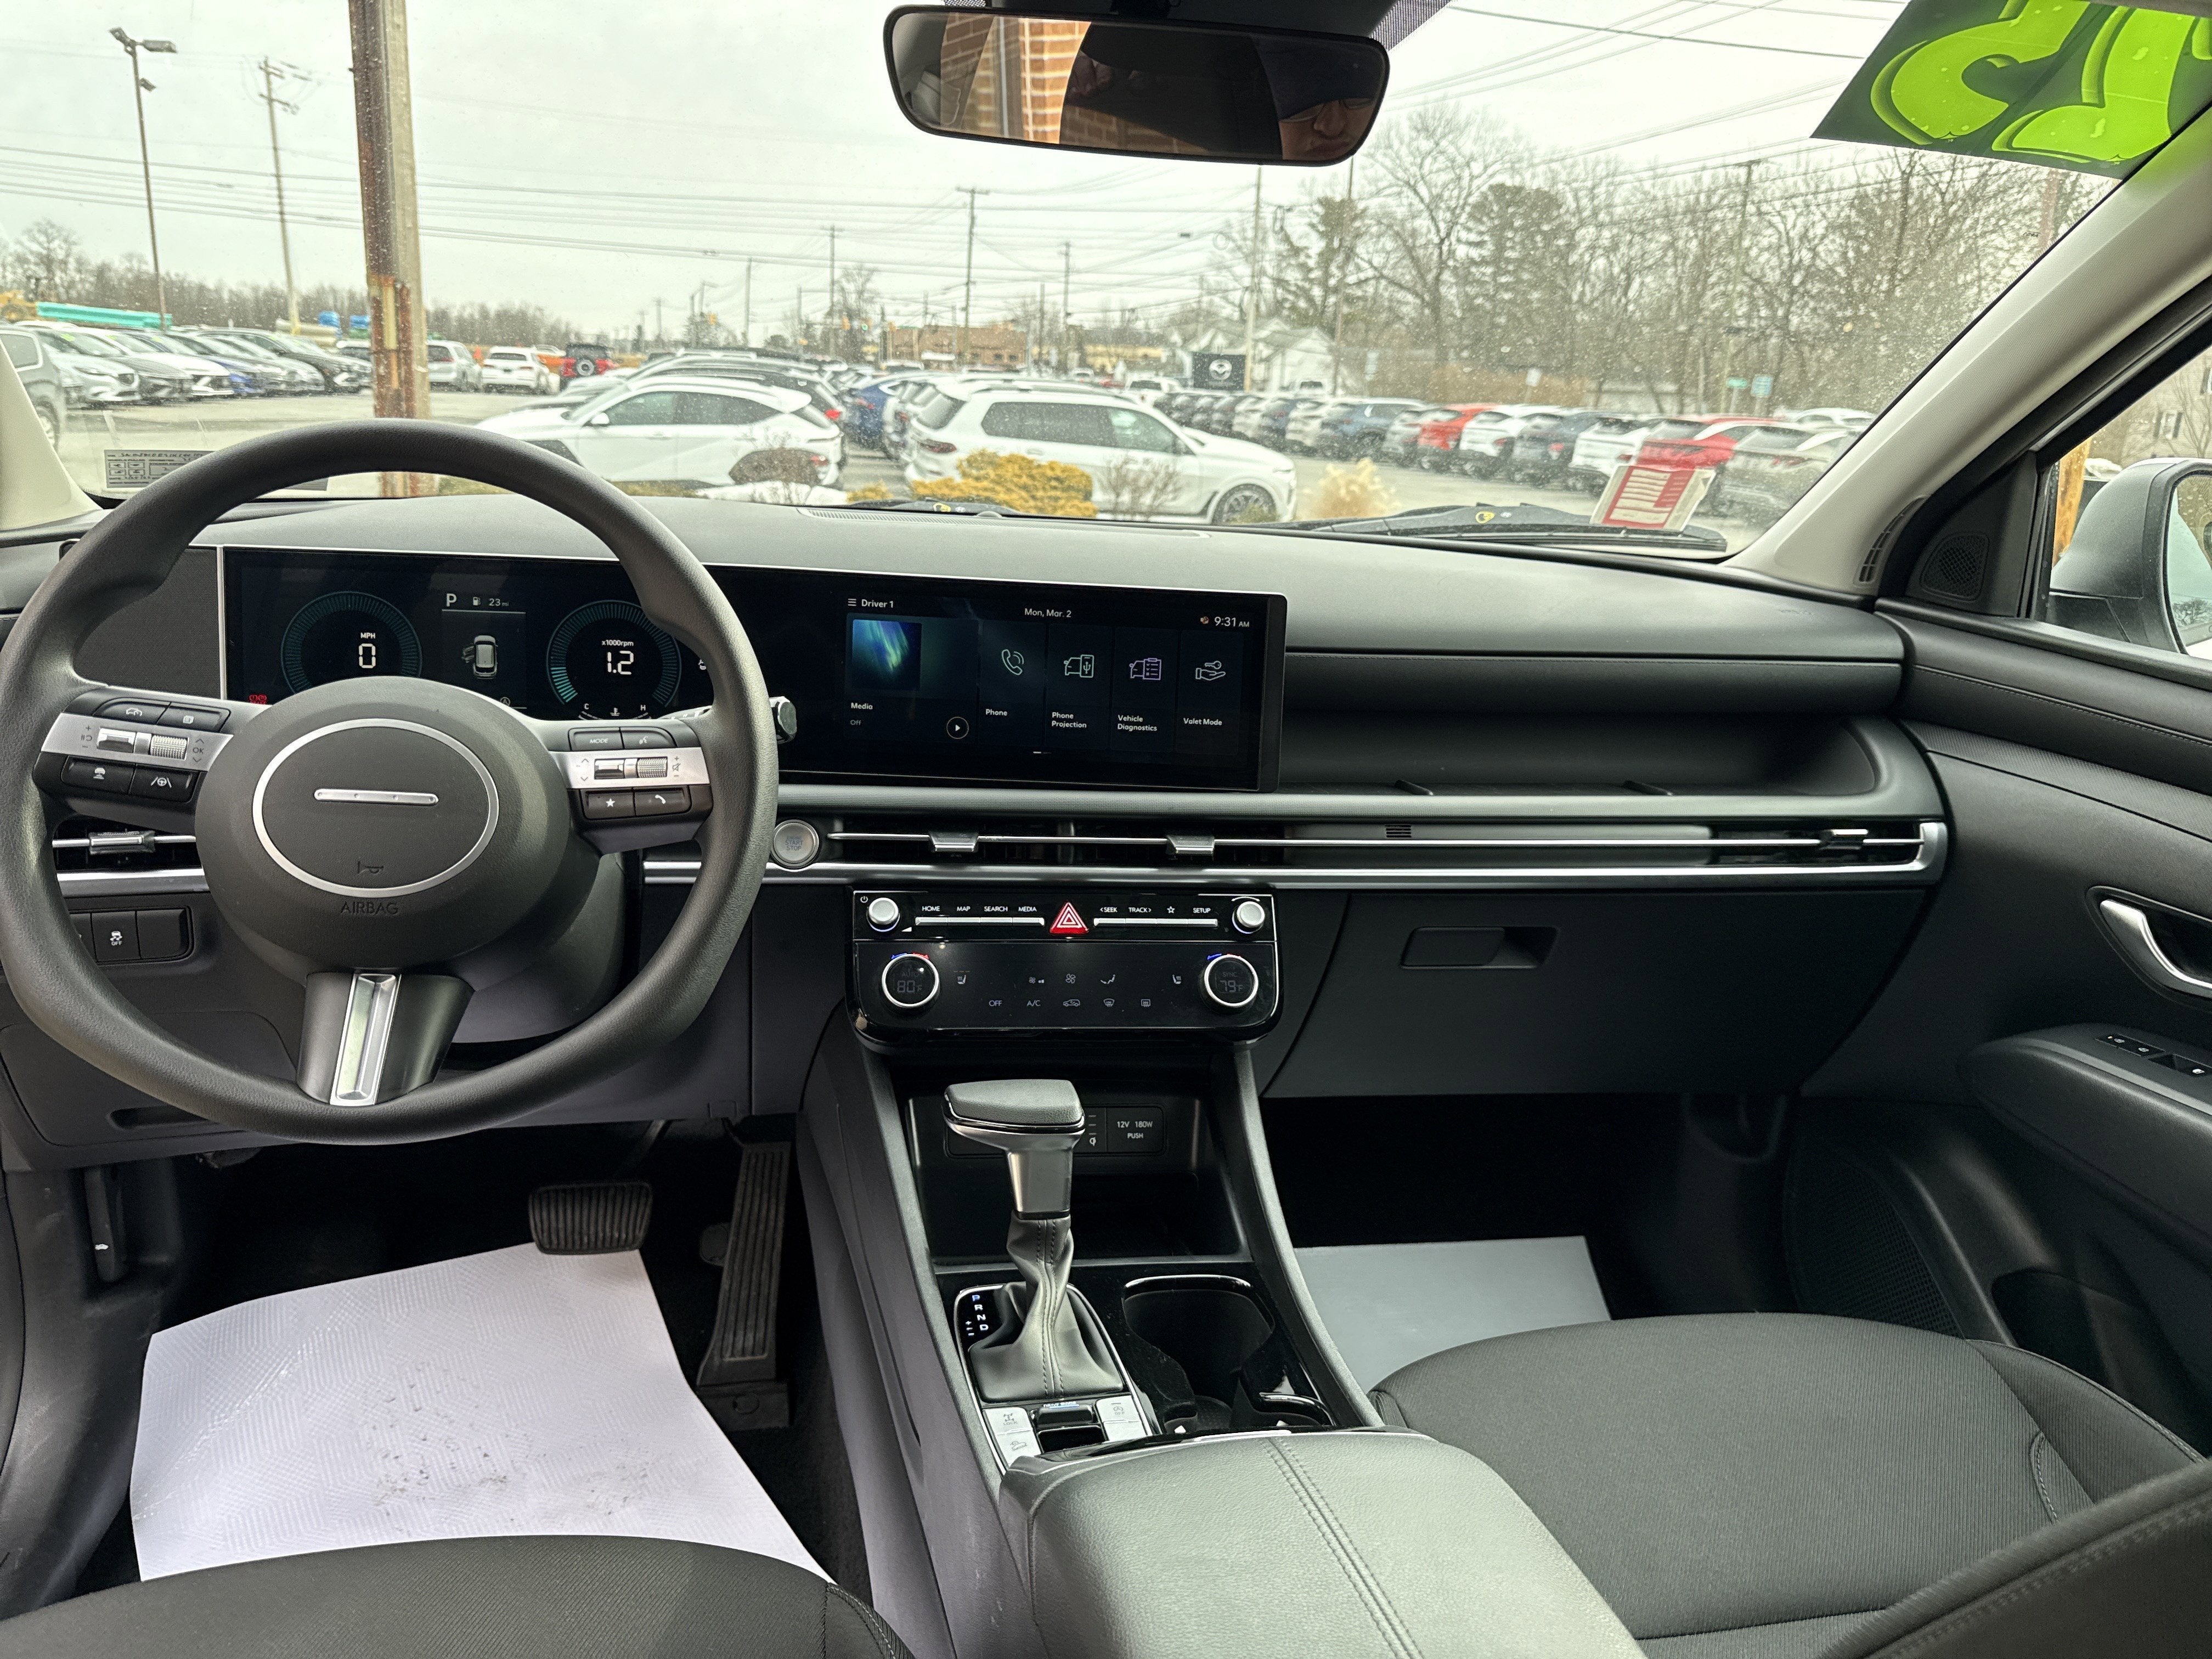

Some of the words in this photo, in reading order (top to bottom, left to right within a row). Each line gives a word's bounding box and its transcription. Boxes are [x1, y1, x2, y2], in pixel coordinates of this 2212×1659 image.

[446, 593, 457, 607] P
[489, 598, 501, 606] 23
[861, 599, 888, 608] Driver
[889, 600, 894, 608] 1
[1024, 608, 1045, 618] Mon,
[1046, 609, 1064, 617] Mar.
[1066, 610, 1071, 618] 2
[1214, 616, 1236, 627] 9:31
[602, 639, 634, 647] x1000rpm
[358, 643, 376, 669] 0
[607, 650, 634, 675] 1.2
[1118, 714, 1143, 723] Vehicle
[1117, 723, 1158, 731] Diagnostics
[340, 901, 400, 916] AIRBAG
